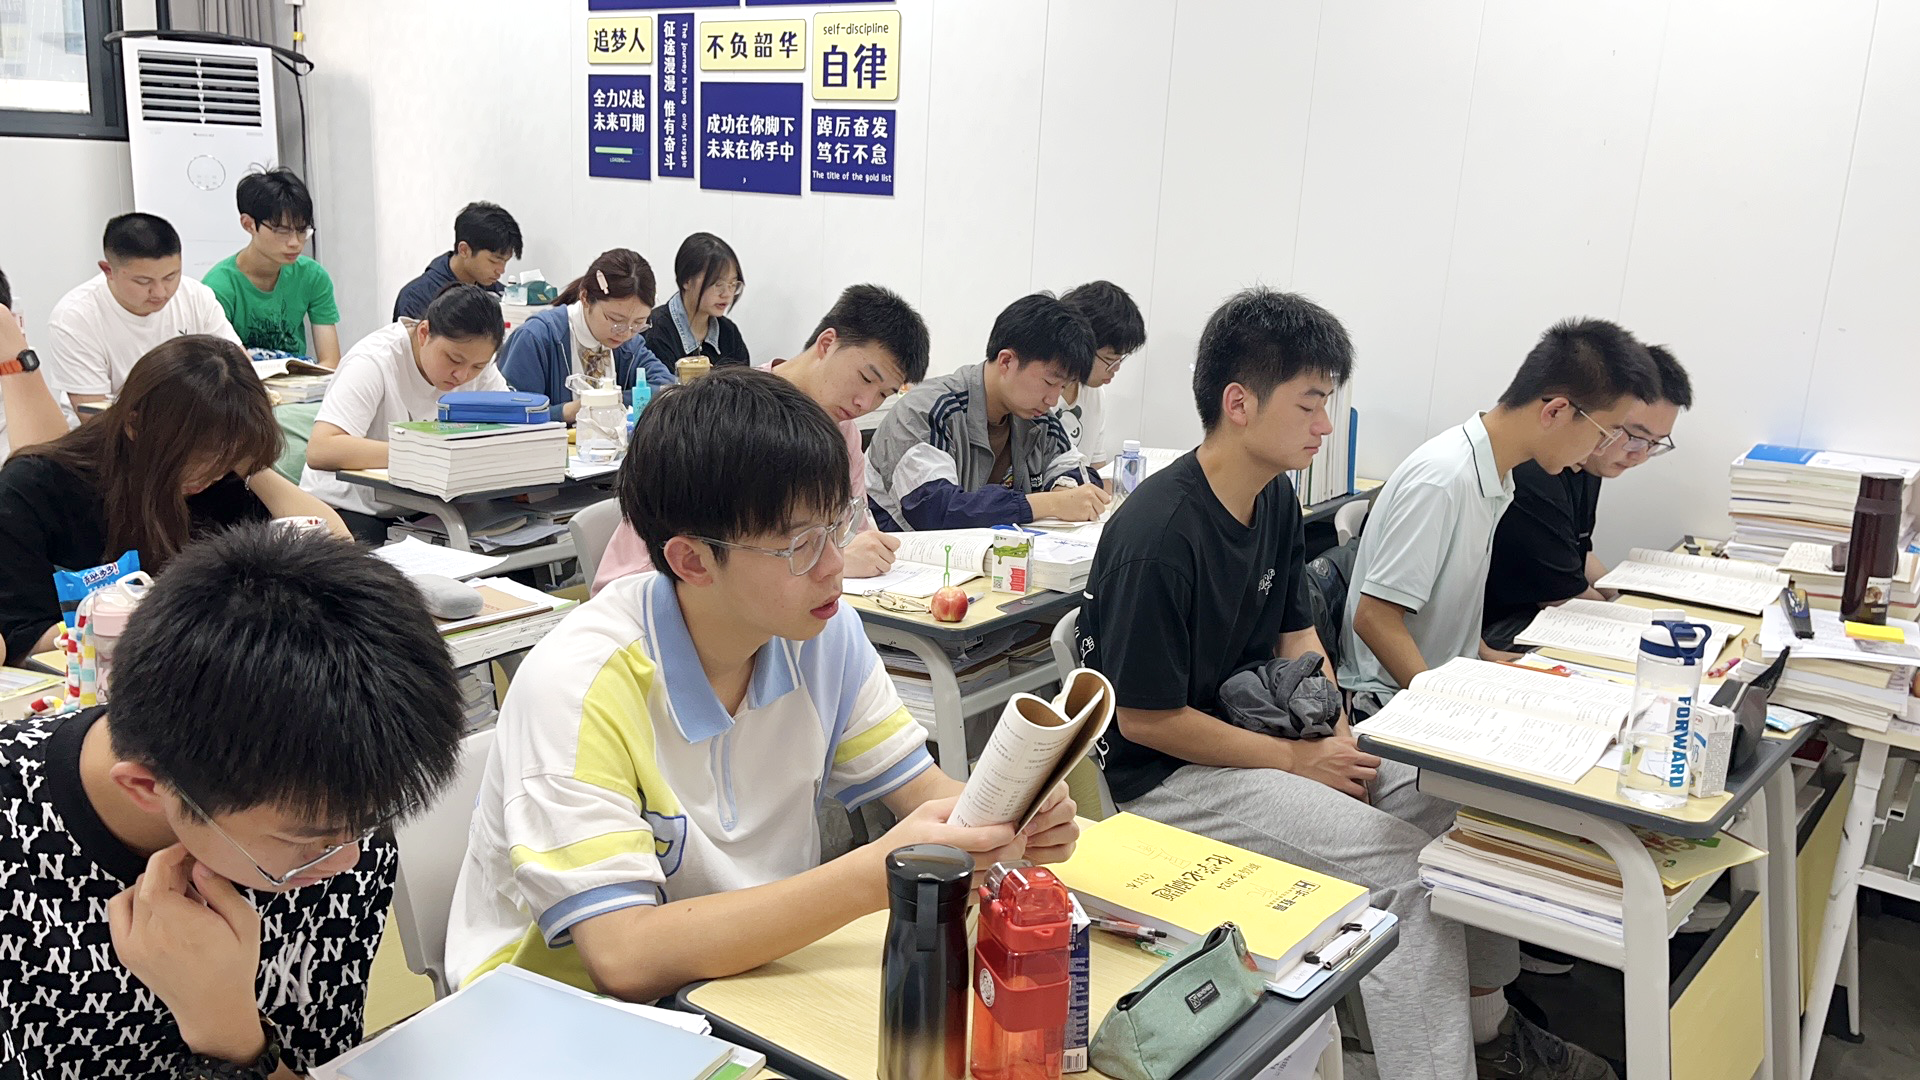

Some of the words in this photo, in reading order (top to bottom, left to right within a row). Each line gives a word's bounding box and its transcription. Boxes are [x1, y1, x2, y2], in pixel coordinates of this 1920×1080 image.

[593, 27, 645, 53] 追梦人
[823, 22, 889, 36] self-discipline
[663, 20, 676, 93] 征途漫漫
[706, 31, 798, 59] 不负韶华
[822, 43, 887, 89] 自律
[593, 88, 645, 109] 全力以赴
[593, 112, 645, 132] 未来可期
[706, 113, 796, 137] 成功在你脚下
[816, 115, 888, 138] 踔厉奋发
[706, 138, 795, 163] 未来在你手中
[816, 142, 887, 165] 笃行不怠
[812, 170, 824, 179] The
[826, 171, 840, 180] title
[842, 171, 850, 180] of
[852, 172, 863, 181] the
[865, 173, 879, 183] gold
[881, 174, 892, 182] list
[1669, 696, 1692, 788] FORWARD
[1151, 853, 1234, 901] 化学必刷题
